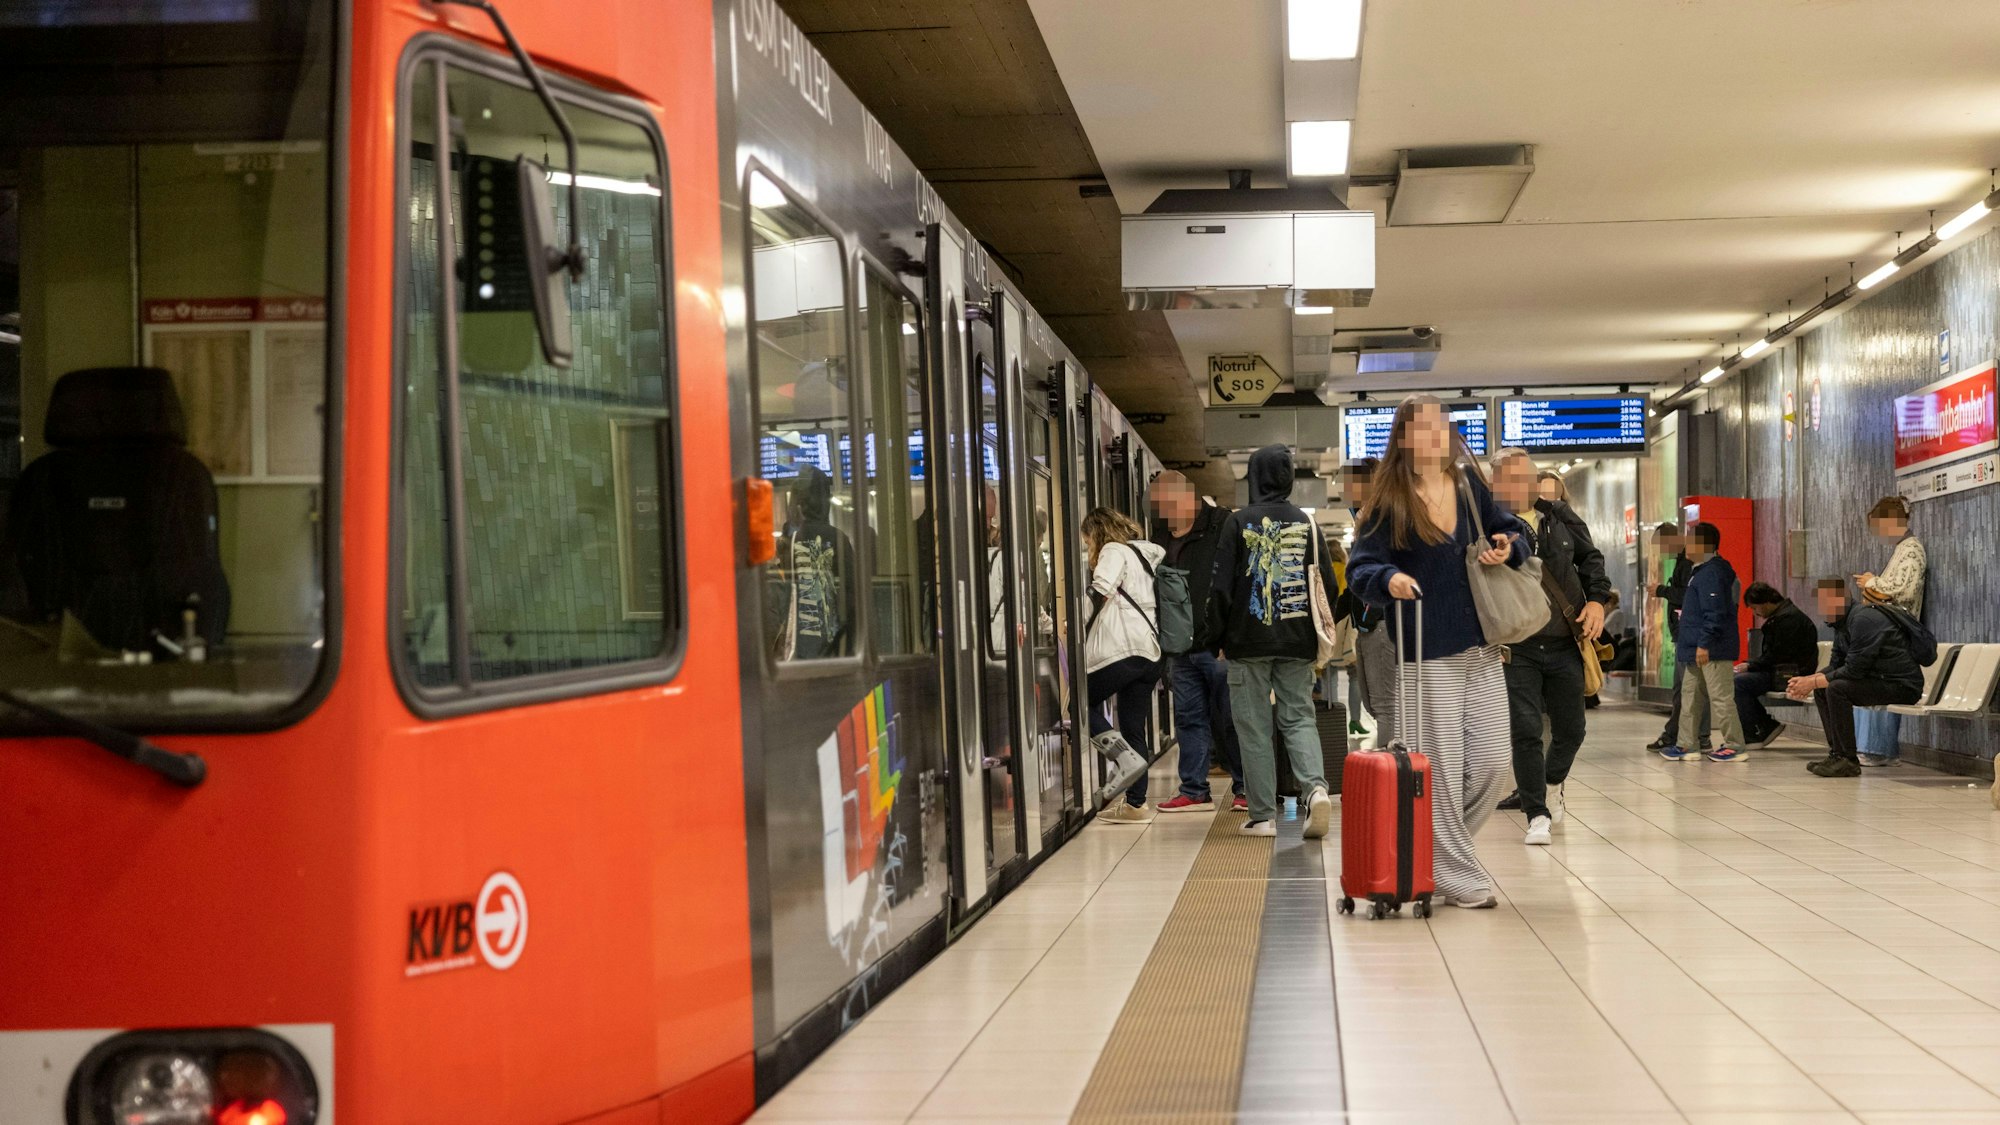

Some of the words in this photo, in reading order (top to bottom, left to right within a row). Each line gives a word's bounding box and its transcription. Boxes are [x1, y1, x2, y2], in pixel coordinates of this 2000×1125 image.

[861, 103, 894, 190] VITRA
[1212, 360, 1257, 373] Notruf
[1231, 379, 1265, 391] SOS
[1522, 409, 1556, 417] Klettenberg
[1533, 423, 1574, 431] Butzweilerhof
[1536, 438, 1546, 446] (H)
[1546, 438, 1577, 446] Ebertplatz
[1577, 437, 1590, 445] sind
[1590, 436, 1621, 445] zusätzliche
[1621, 436, 1645, 444] Bahnen
[1279, 521, 1311, 621] NIRVANA
[408, 902, 474, 963] KVB
